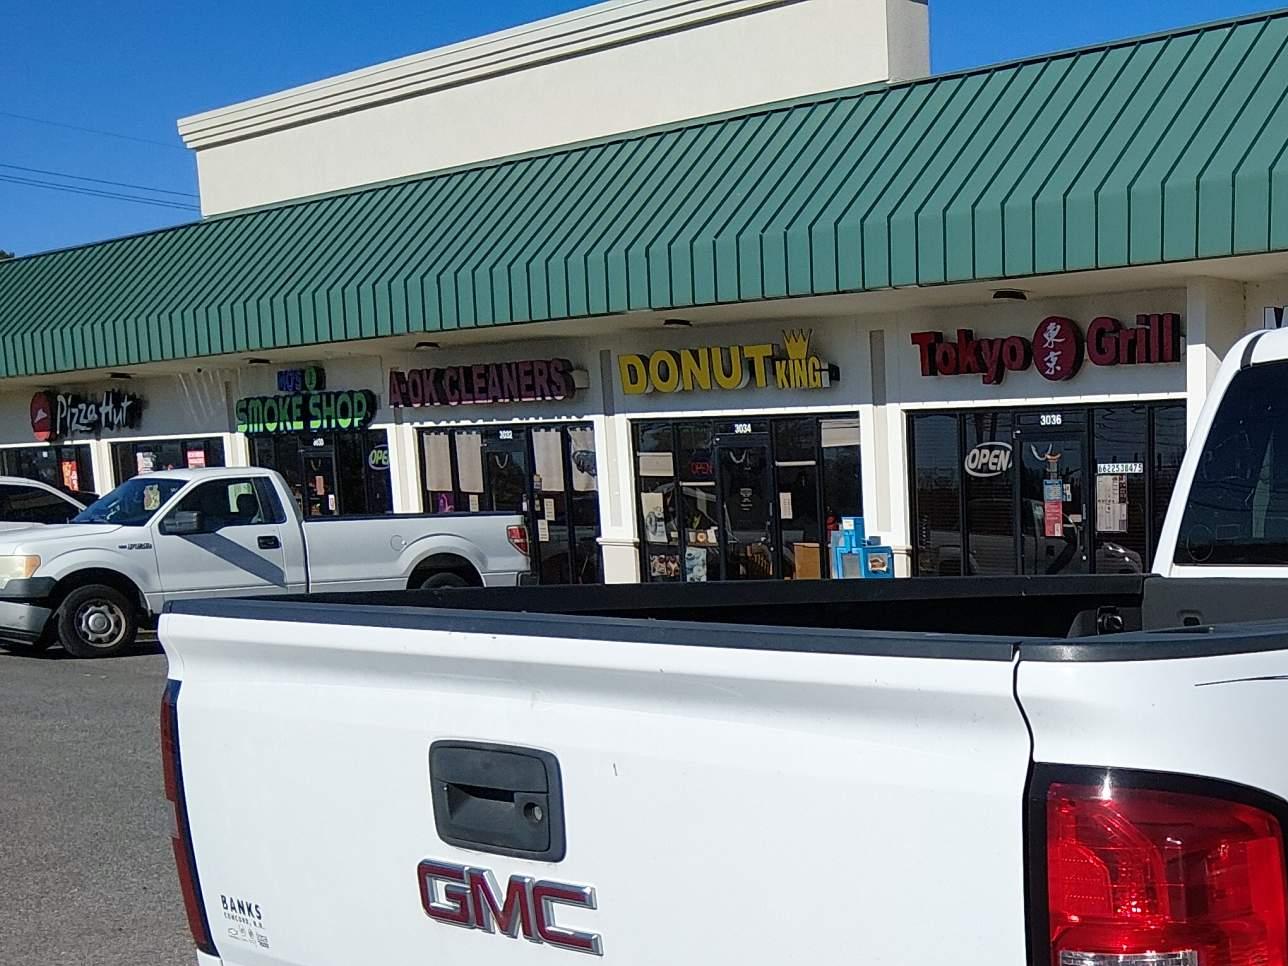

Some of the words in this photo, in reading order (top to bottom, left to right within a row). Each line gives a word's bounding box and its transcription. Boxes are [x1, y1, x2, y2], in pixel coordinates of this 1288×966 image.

[618, 344, 774, 395] DONUT
[775, 355, 824, 389] KING
[911, 329, 1028, 384] Tokyo
[1087, 313, 1178, 366] Grill
[445, 359, 568, 405] CLEANERS
[56, 394, 98, 434] Pizza
[100, 391, 133, 430] Hut
[237, 394, 304, 433] SMOKE
[309, 391, 367, 430] SHOP
[734, 424, 752, 434] 3034
[1040, 414, 1062, 426] 3036
[967, 448, 1011, 471] OPEN
[220, 894, 262, 920] BANKS
[417, 858, 604, 956] GMC
